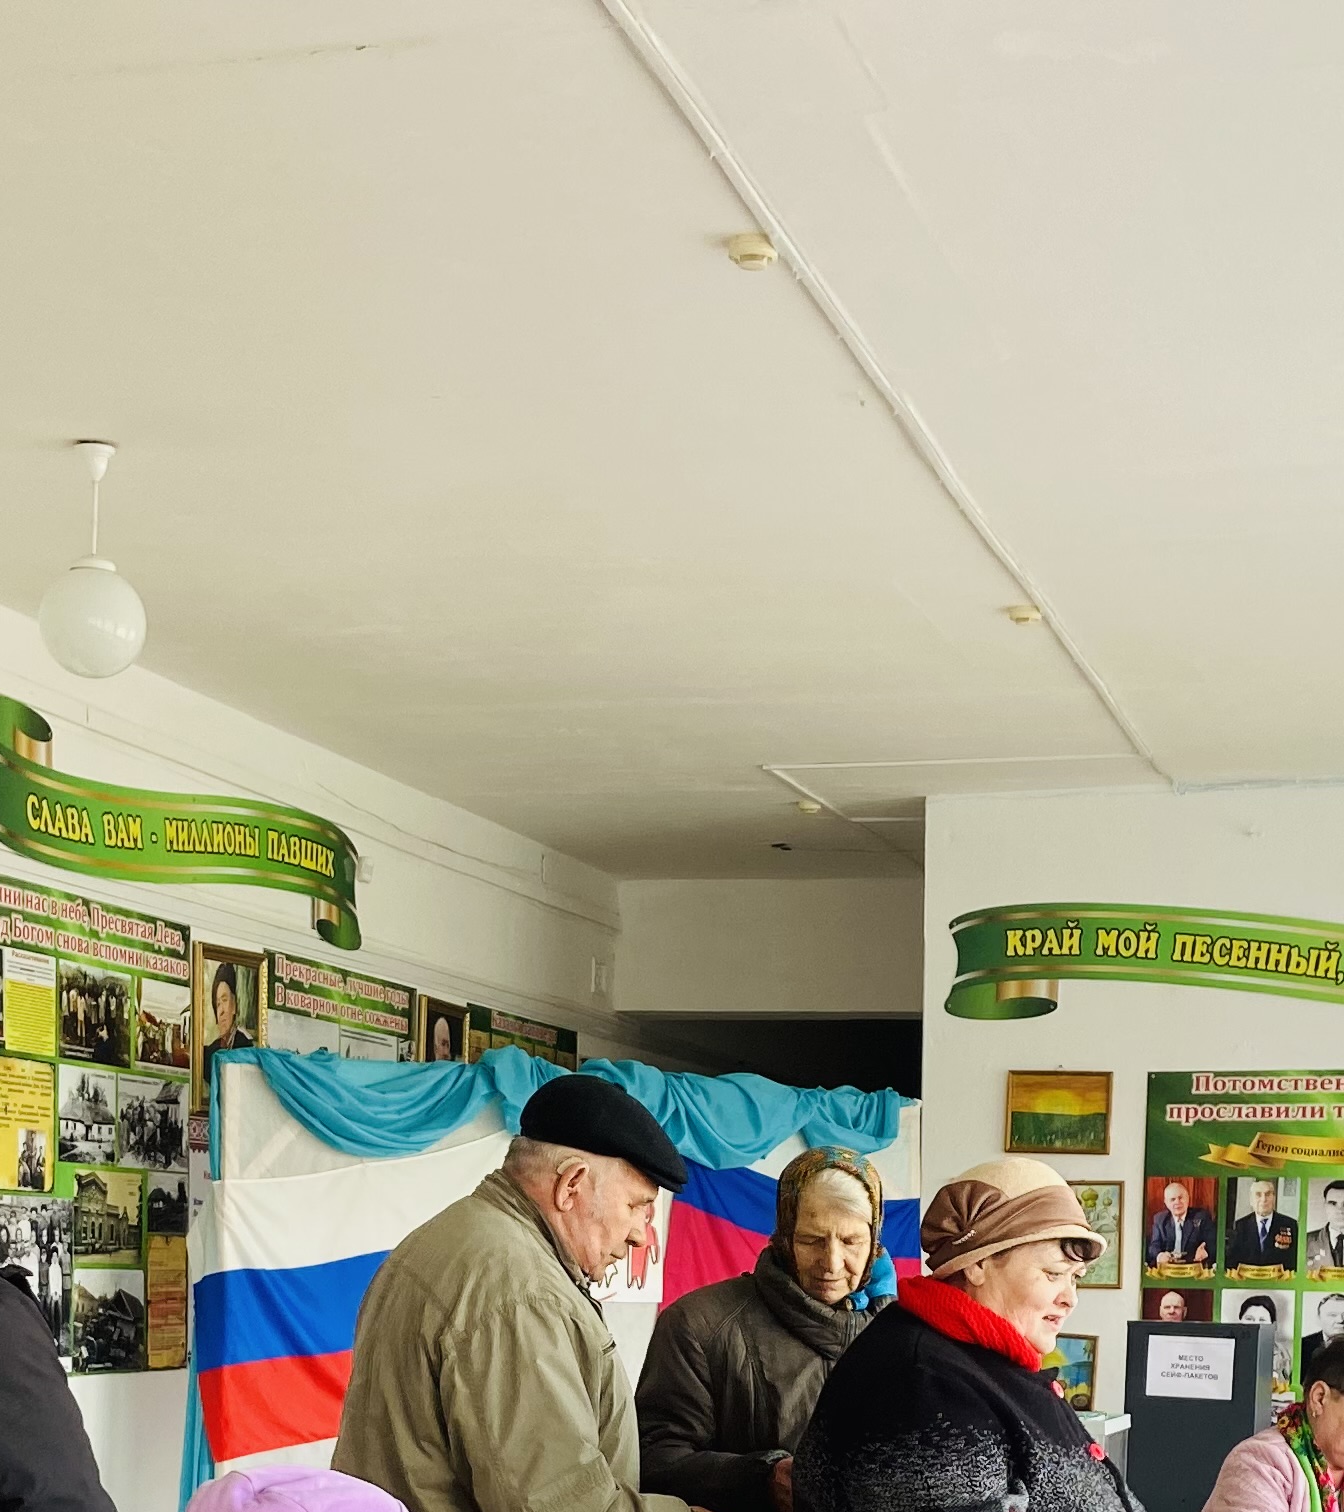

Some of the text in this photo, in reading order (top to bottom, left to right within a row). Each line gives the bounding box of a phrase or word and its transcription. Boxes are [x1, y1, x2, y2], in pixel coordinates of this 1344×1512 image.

[26, 793, 95, 844] СЛАВА
[102, 811, 144, 850] ВАМ
[164, 818, 260, 857] МИЛЛИОНЫ
[266, 828, 335, 878] ПАВШИХ
[26, 892, 47, 913] нас
[51, 900, 57, 911] в
[92, 906, 154, 940] Пресвятая
[14, 917, 53, 945] Богом
[57, 932, 90, 953] снова
[94, 942, 143, 967] вспомни
[146, 954, 189, 978] казаков
[1005, 919, 1083, 957] КРАЙ
[1095, 922, 1159, 960] МОЙ
[276, 985, 284, 1003] В
[287, 992, 338, 1016] коварном
[341, 1006, 363, 1020] огне
[1168, 1105, 1325, 1123] прославили
[1170, 1363, 1210, 1371] ХРАНЕНИЯ
[1178, 1354, 1204, 1362] МЕСТО
[1161, 1371, 1219, 1381] СЕЙФ-ПАКЕТОВ
